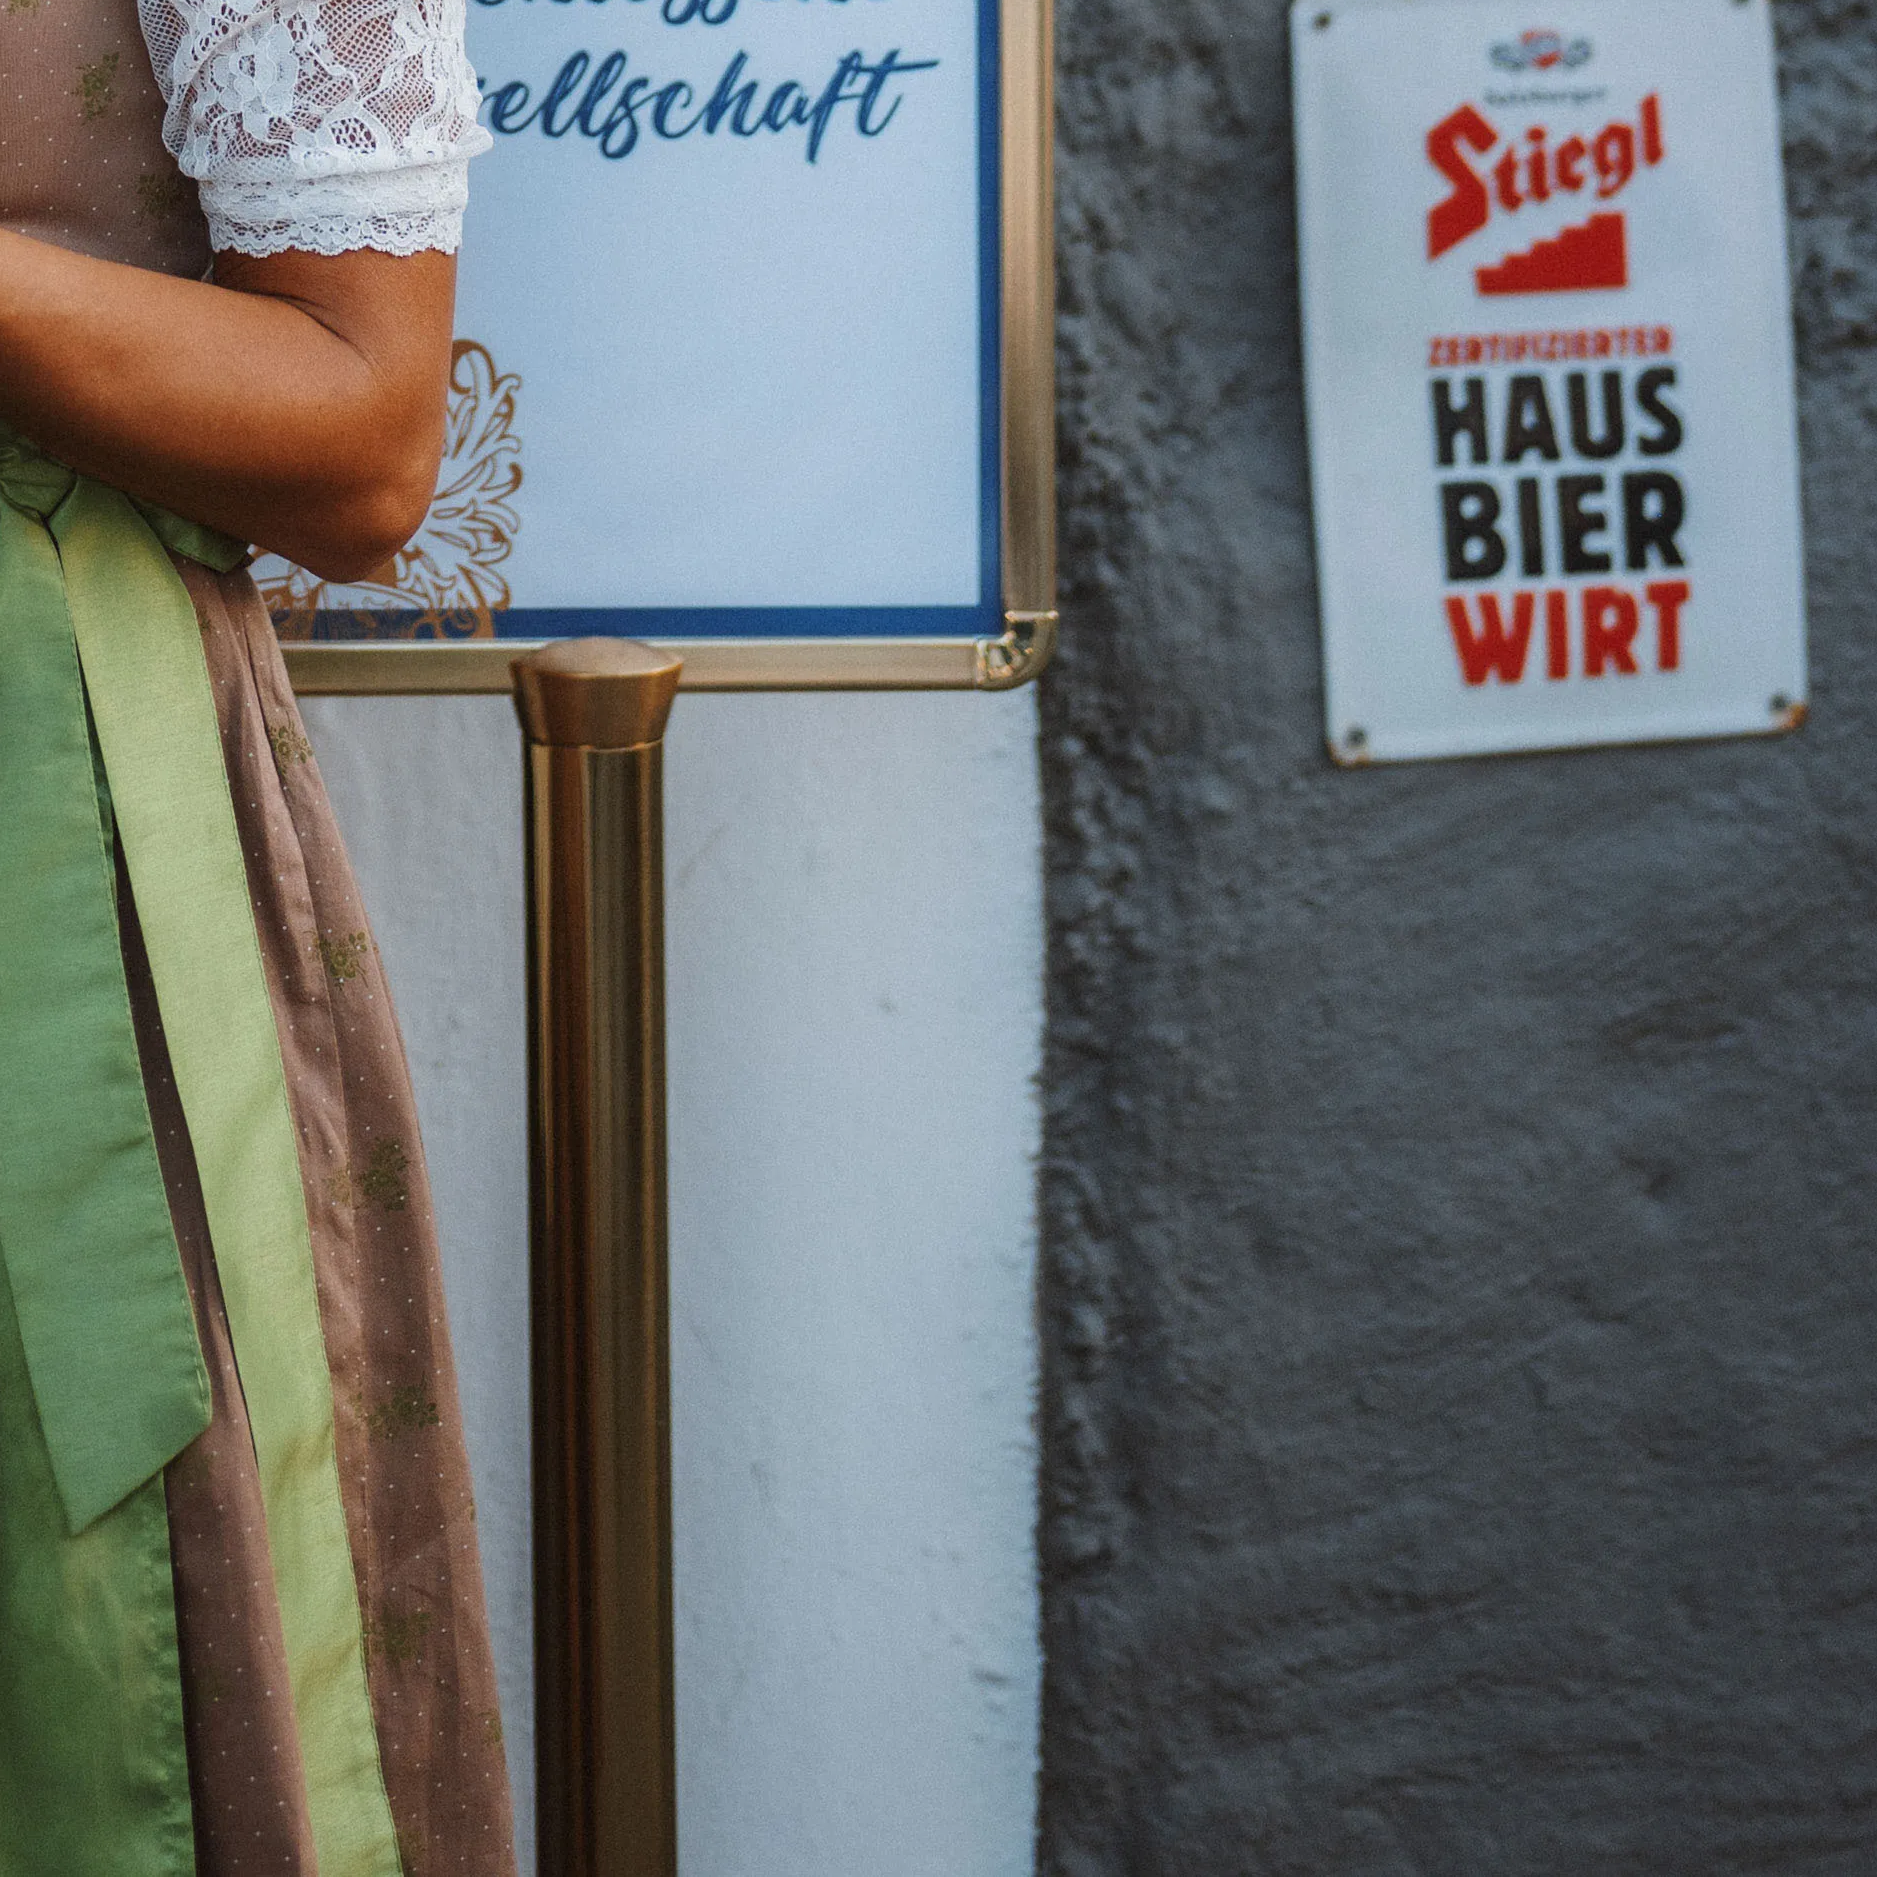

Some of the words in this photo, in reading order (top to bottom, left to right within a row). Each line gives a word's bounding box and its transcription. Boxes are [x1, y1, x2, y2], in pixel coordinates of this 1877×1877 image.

[477, 47, 940, 165] ellschaft
[1425, 91, 1665, 261] Stiegl
[1431, 365, 1683, 467] HAUS
[1439, 471, 1686, 581] BIER
[1443, 579, 1691, 687] WIRT
